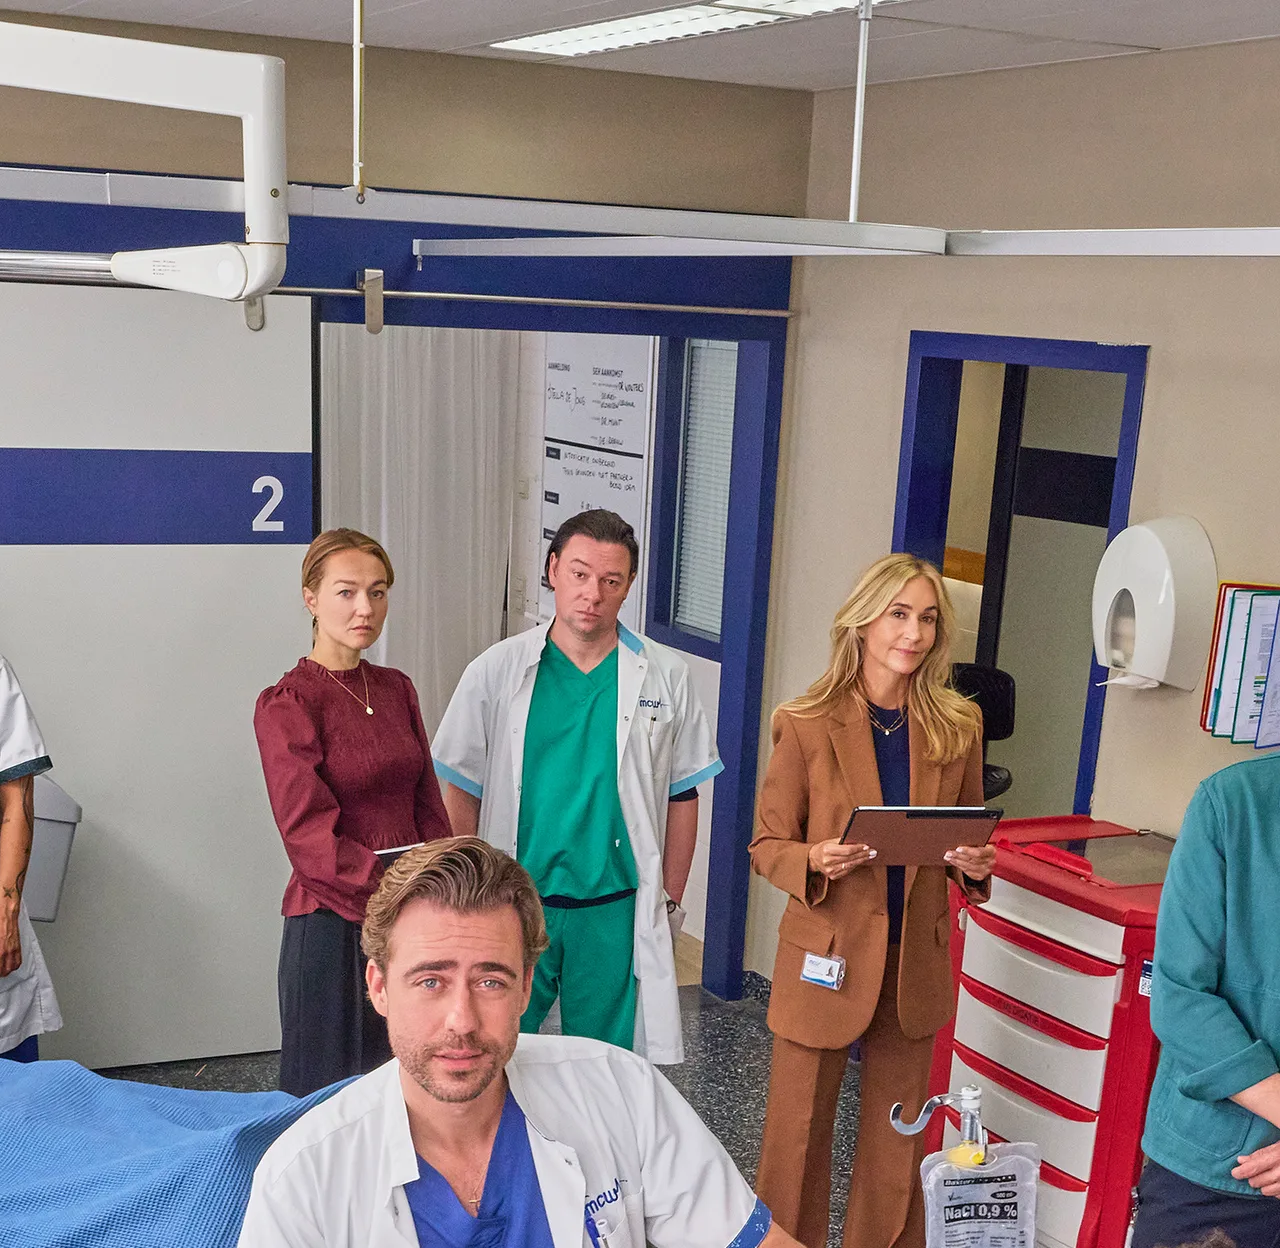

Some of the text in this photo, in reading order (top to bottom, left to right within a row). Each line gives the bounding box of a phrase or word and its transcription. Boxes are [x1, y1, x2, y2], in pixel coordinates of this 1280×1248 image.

[251, 475, 284, 532] 2
[945, 1204, 1017, 1221] NaCl 0,9 %
